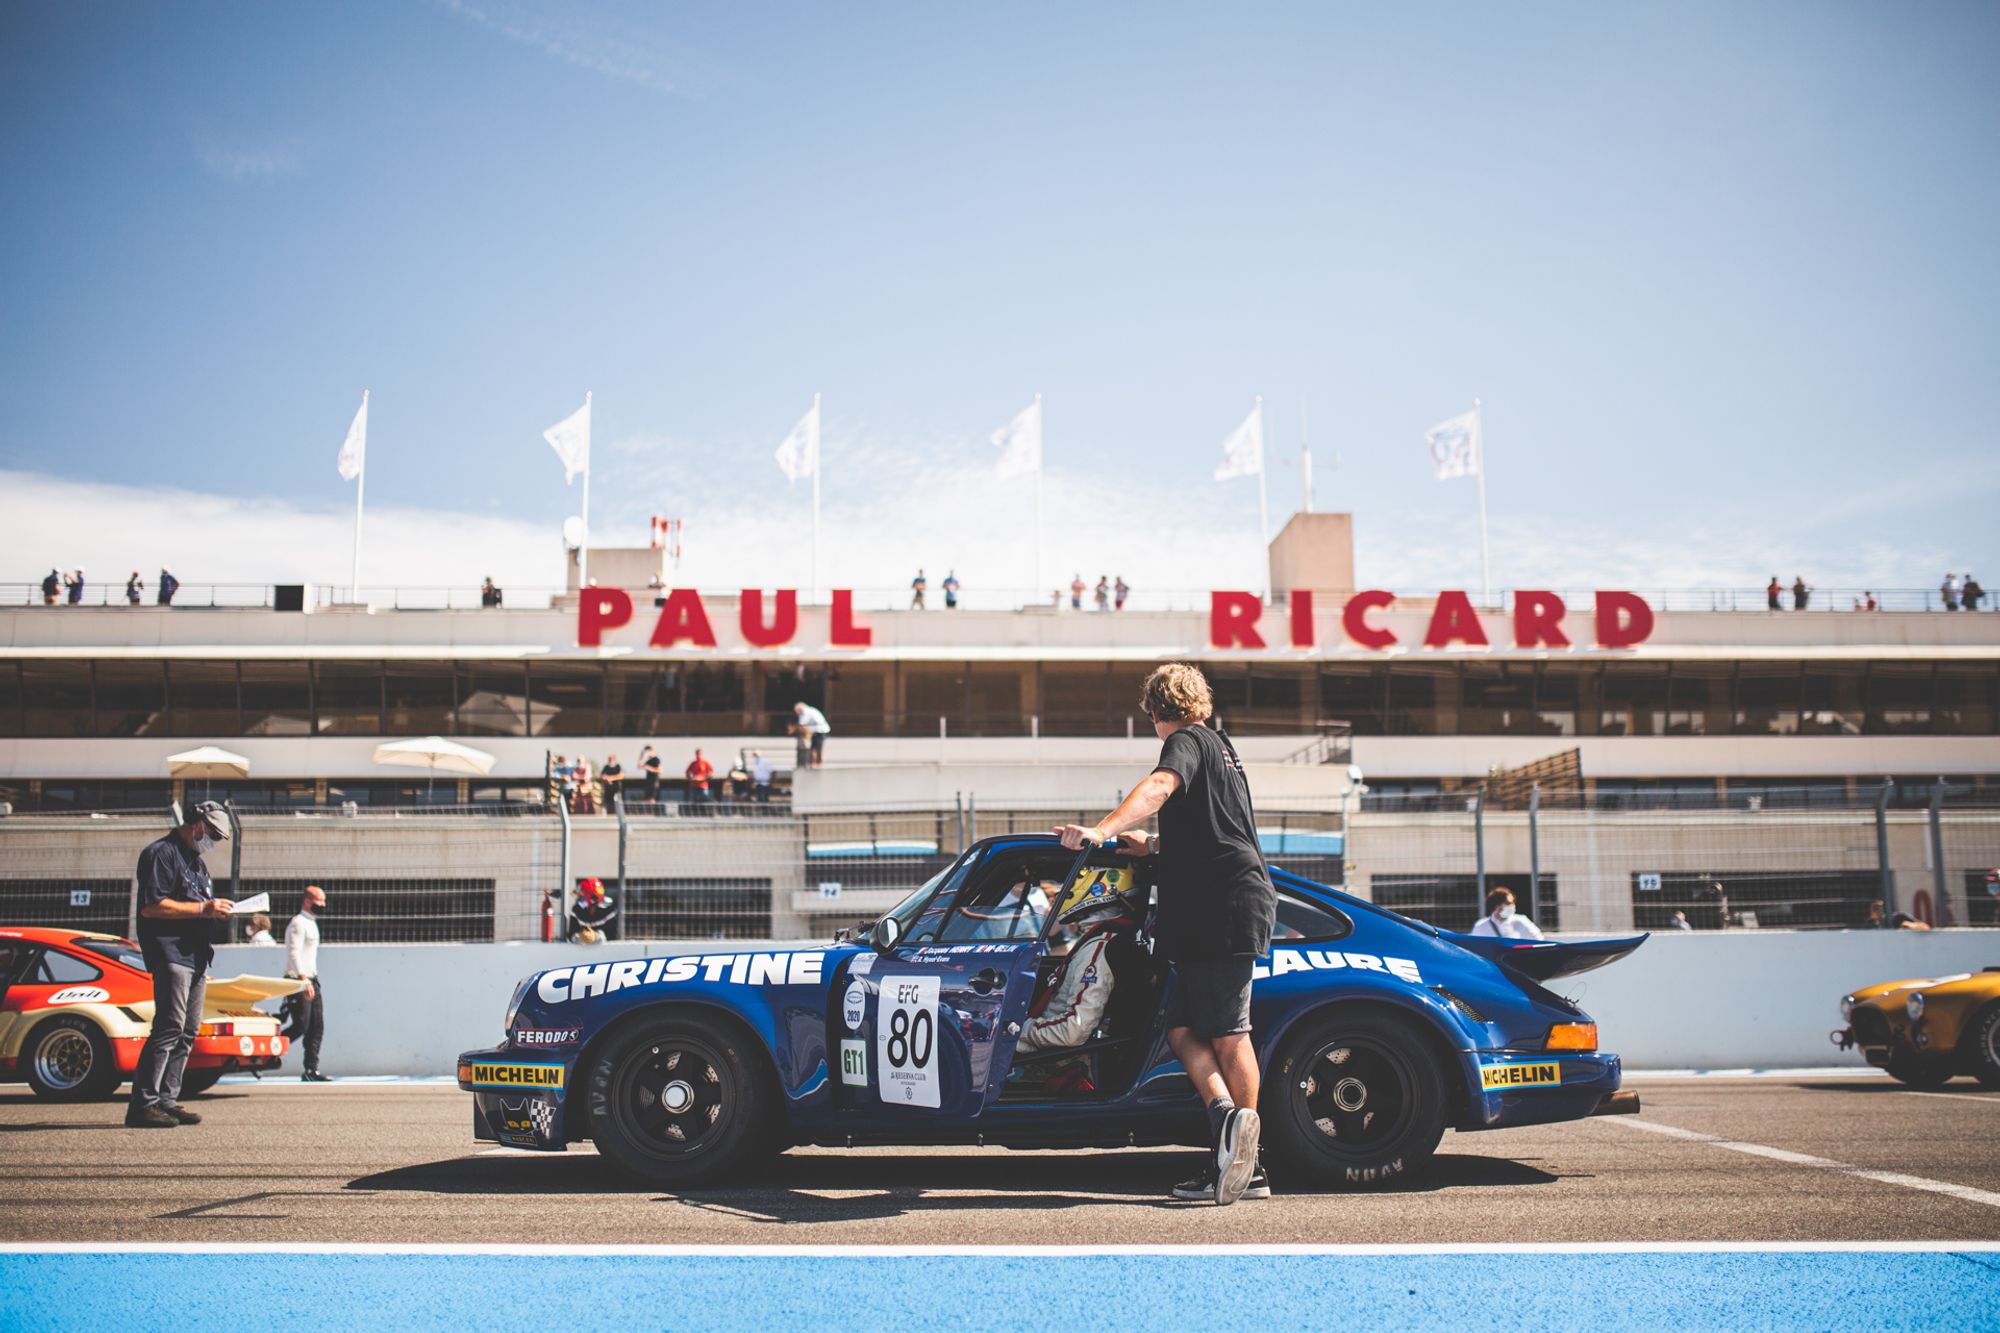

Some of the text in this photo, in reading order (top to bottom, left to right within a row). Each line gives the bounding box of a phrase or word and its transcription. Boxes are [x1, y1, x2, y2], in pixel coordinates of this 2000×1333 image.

[578, 588, 1655, 649] PAUL RICARD
[538, 951, 825, 1004] CHRISTINE
[1252, 949, 1423, 984] LAURE
[898, 984, 920, 1004] EFG
[847, 1010, 861, 1022] 2020
[517, 1030, 567, 1043] FERODO
[887, 1008, 933, 1069] 80
[844, 1049, 864, 1075] GT1
[475, 1066, 560, 1084] MICHELIN
[1483, 1065, 1555, 1085] MICHELIN
